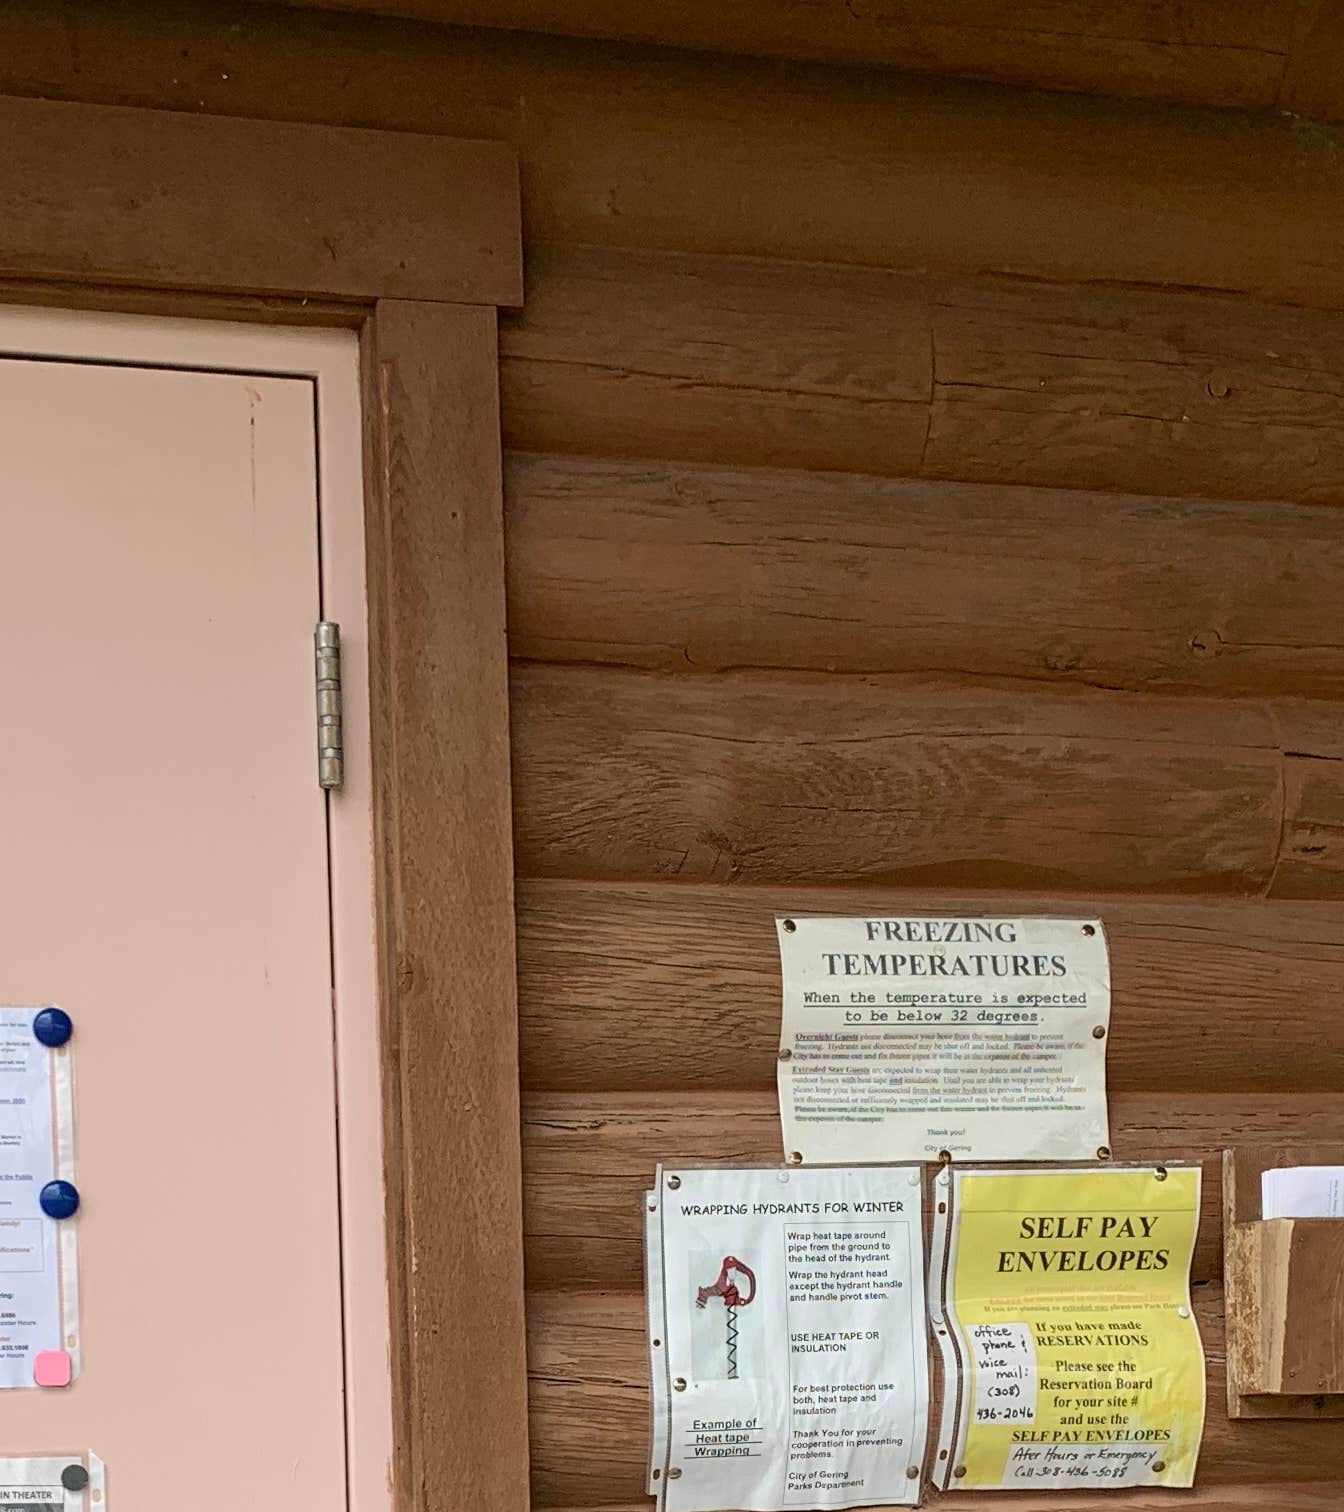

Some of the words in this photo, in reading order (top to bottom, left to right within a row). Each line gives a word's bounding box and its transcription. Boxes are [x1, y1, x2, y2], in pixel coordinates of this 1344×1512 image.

[866, 920, 1018, 944] FREEZING
[822, 953, 1067, 977] TEMPERATURES
[804, 992, 840, 1004] When
[850, 992, 876, 1004] the
[886, 992, 983, 1006] temperature
[992, 992, 1008, 1004] is
[1017, 992, 1086, 1006] expected
[845, 1011, 862, 1022] to
[871, 1010, 888, 1022] be
[896, 1010, 942, 1022] below
[951, 1010, 968, 1022] 32
[977, 1010, 1045, 1025] degrees.
[681, 1204, 748, 1216] WRAPPING
[752, 1203, 820, 1214] HYDRANTS
[824, 1203, 849, 1214] FOR
[853, 1201, 904, 1213] WINTER
[1019, 1216, 1093, 1239] SELF
[1099, 1216, 1159, 1238] PAY
[787, 1232, 811, 1242] Wrap
[813, 1232, 832, 1240] heat
[834, 1232, 852, 1241] tape
[854, 1231, 886, 1239] around
[997, 1249, 1170, 1273] ENVELOPES
[1036, 1322, 1048, 1332] If
[1050, 1323, 1075, 1336] you
[1077, 1321, 1105, 1331] have
[1108, 1321, 1142, 1331] made
[791, 1333, 810, 1342] USE
[812, 1333, 836, 1341] HEAT
[838, 1332, 863, 1341] TAPE
[865, 1332, 879, 1340] OR
[1037, 1334, 1149, 1347] RESERVATIONS
[791, 1344, 847, 1353] INSULATION
[1055, 1360, 1093, 1373] Please
[1096, 1362, 1115, 1372] see
[1118, 1361, 1137, 1372] the
[1040, 1378, 1113, 1390] Reservation
[1115, 1378, 1153, 1390] Board
[1053, 1396, 1072, 1407] for
[1074, 1398, 1103, 1410] your
[1106, 1396, 1127, 1407] site
[1129, 1397, 1139, 1407] #
[977, 1407, 1033, 1419] 436-2046
[1060, 1414, 1083, 1425] and
[1086, 1416, 1108, 1425] use
[1110, 1414, 1129, 1425] the
[693, 1419, 743, 1430] Example
[745, 1418, 757, 1428] of
[696, 1433, 722, 1443] Heat
[725, 1433, 750, 1443] tape
[1012, 1430, 1049, 1442] SELF
[1052, 1430, 1082, 1441] PAY
[1086, 1429, 1171, 1441] ENVELOPES
[694, 1446, 750, 1458] Wrapping
[13, 1491, 53, 1499] THEATER
